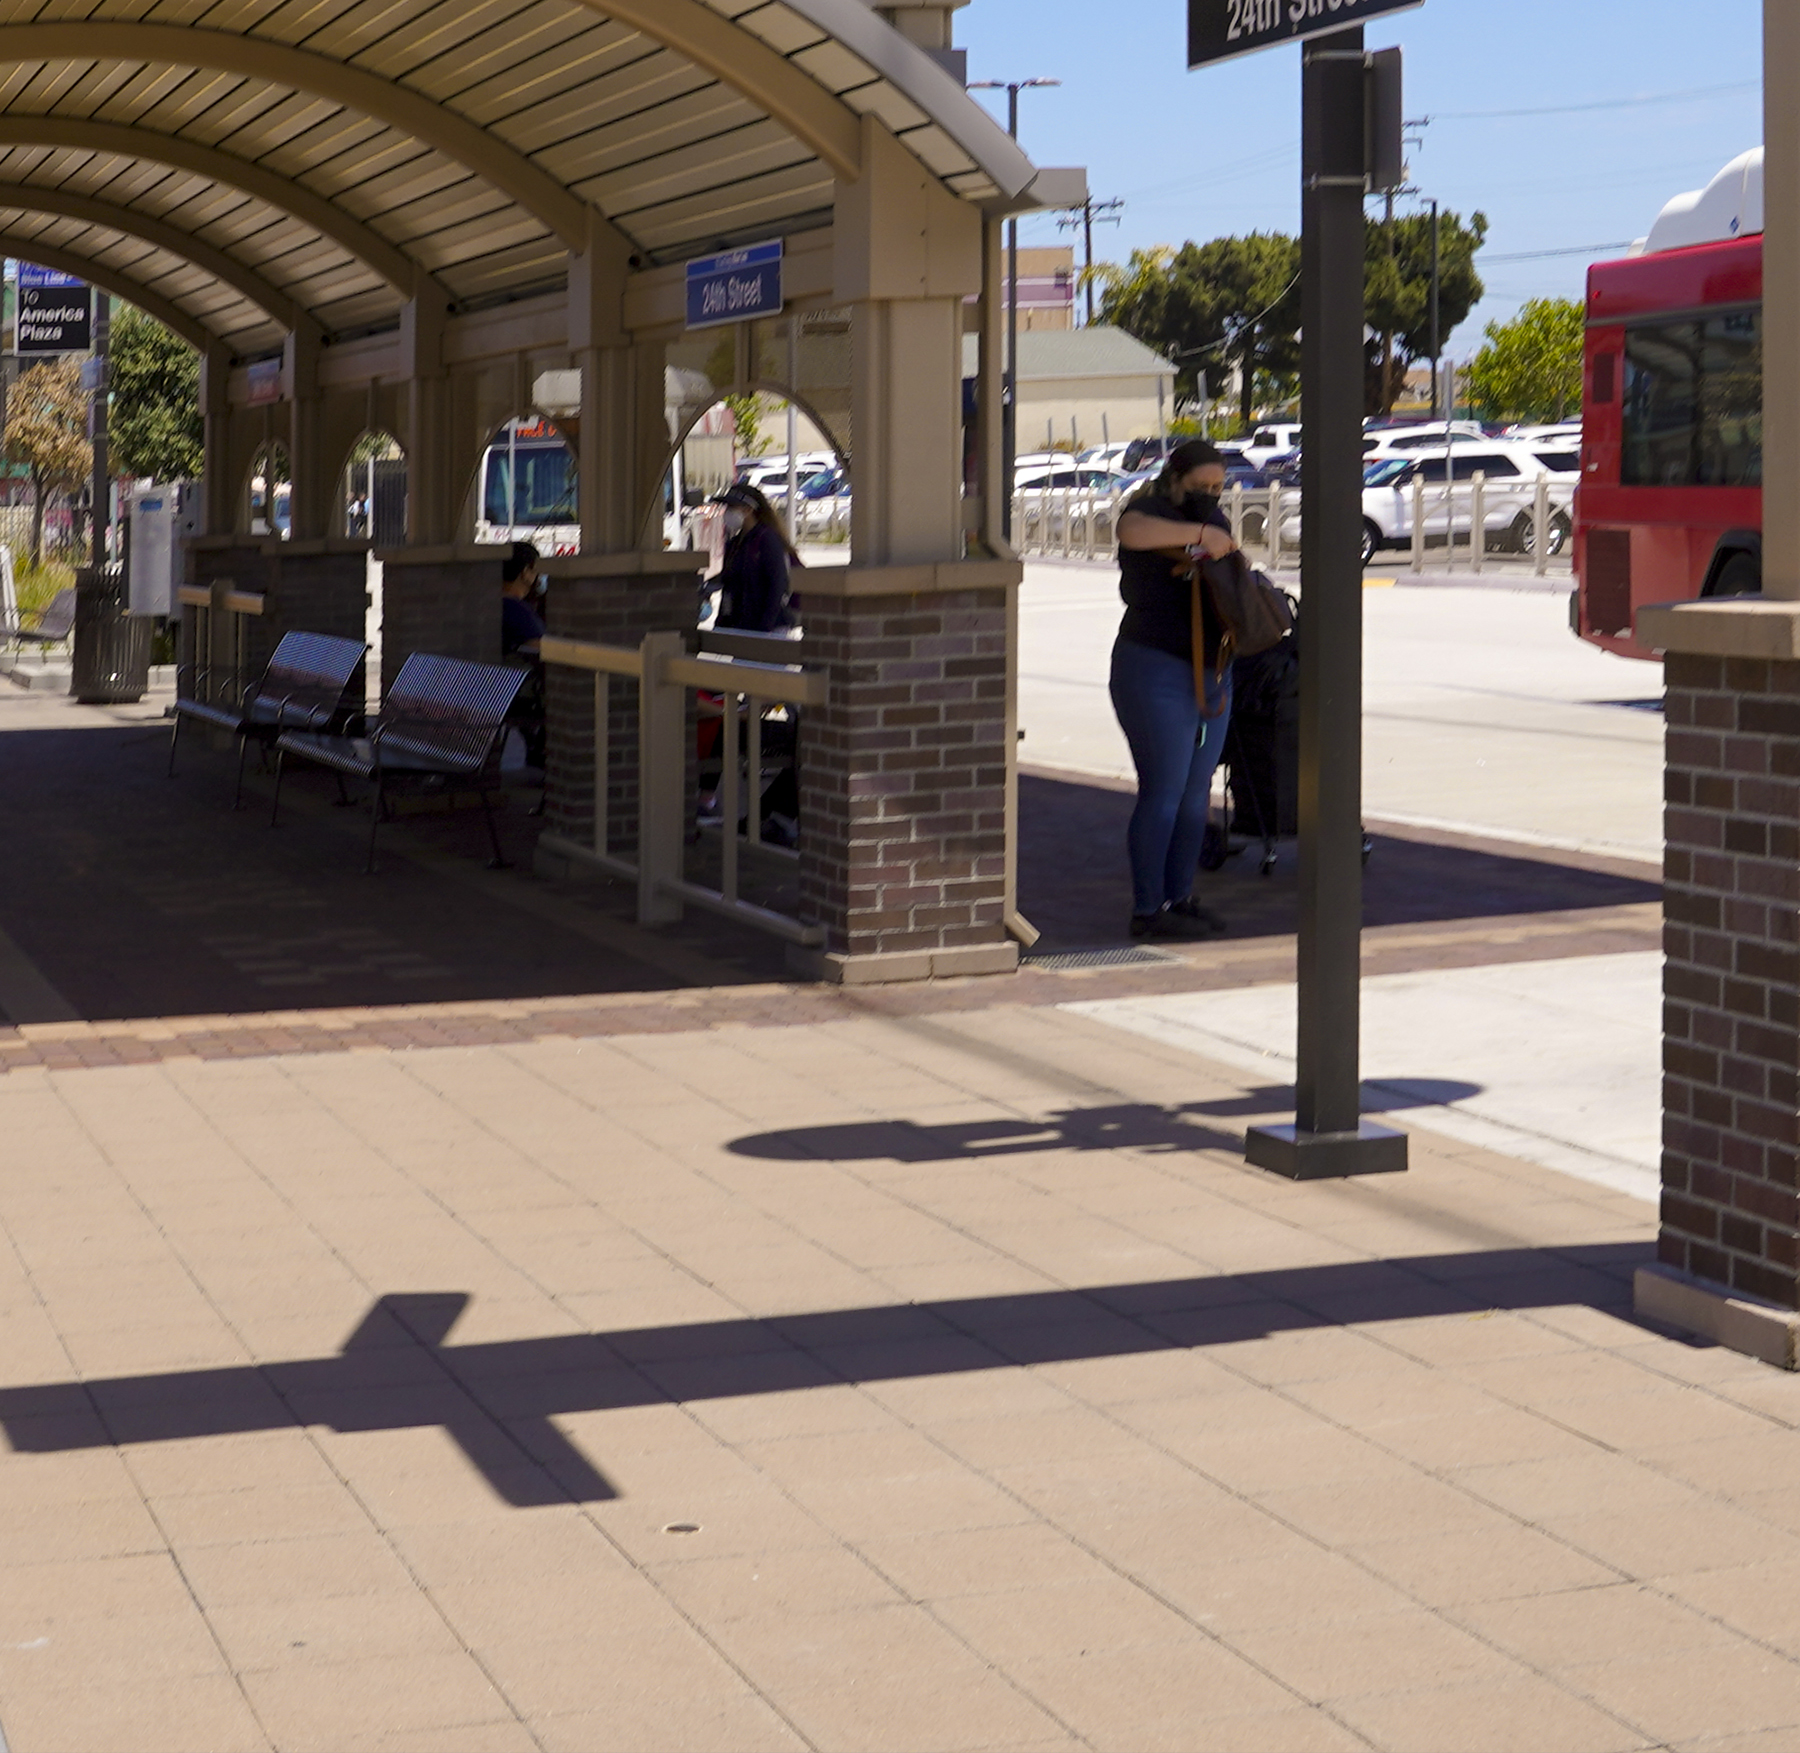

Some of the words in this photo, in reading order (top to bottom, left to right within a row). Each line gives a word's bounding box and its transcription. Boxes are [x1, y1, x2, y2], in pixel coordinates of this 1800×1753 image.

[702, 280, 727, 314] 24th
[728, 272, 762, 311] Street
[20, 305, 85, 323] America
[20, 324, 63, 342] Plaza
